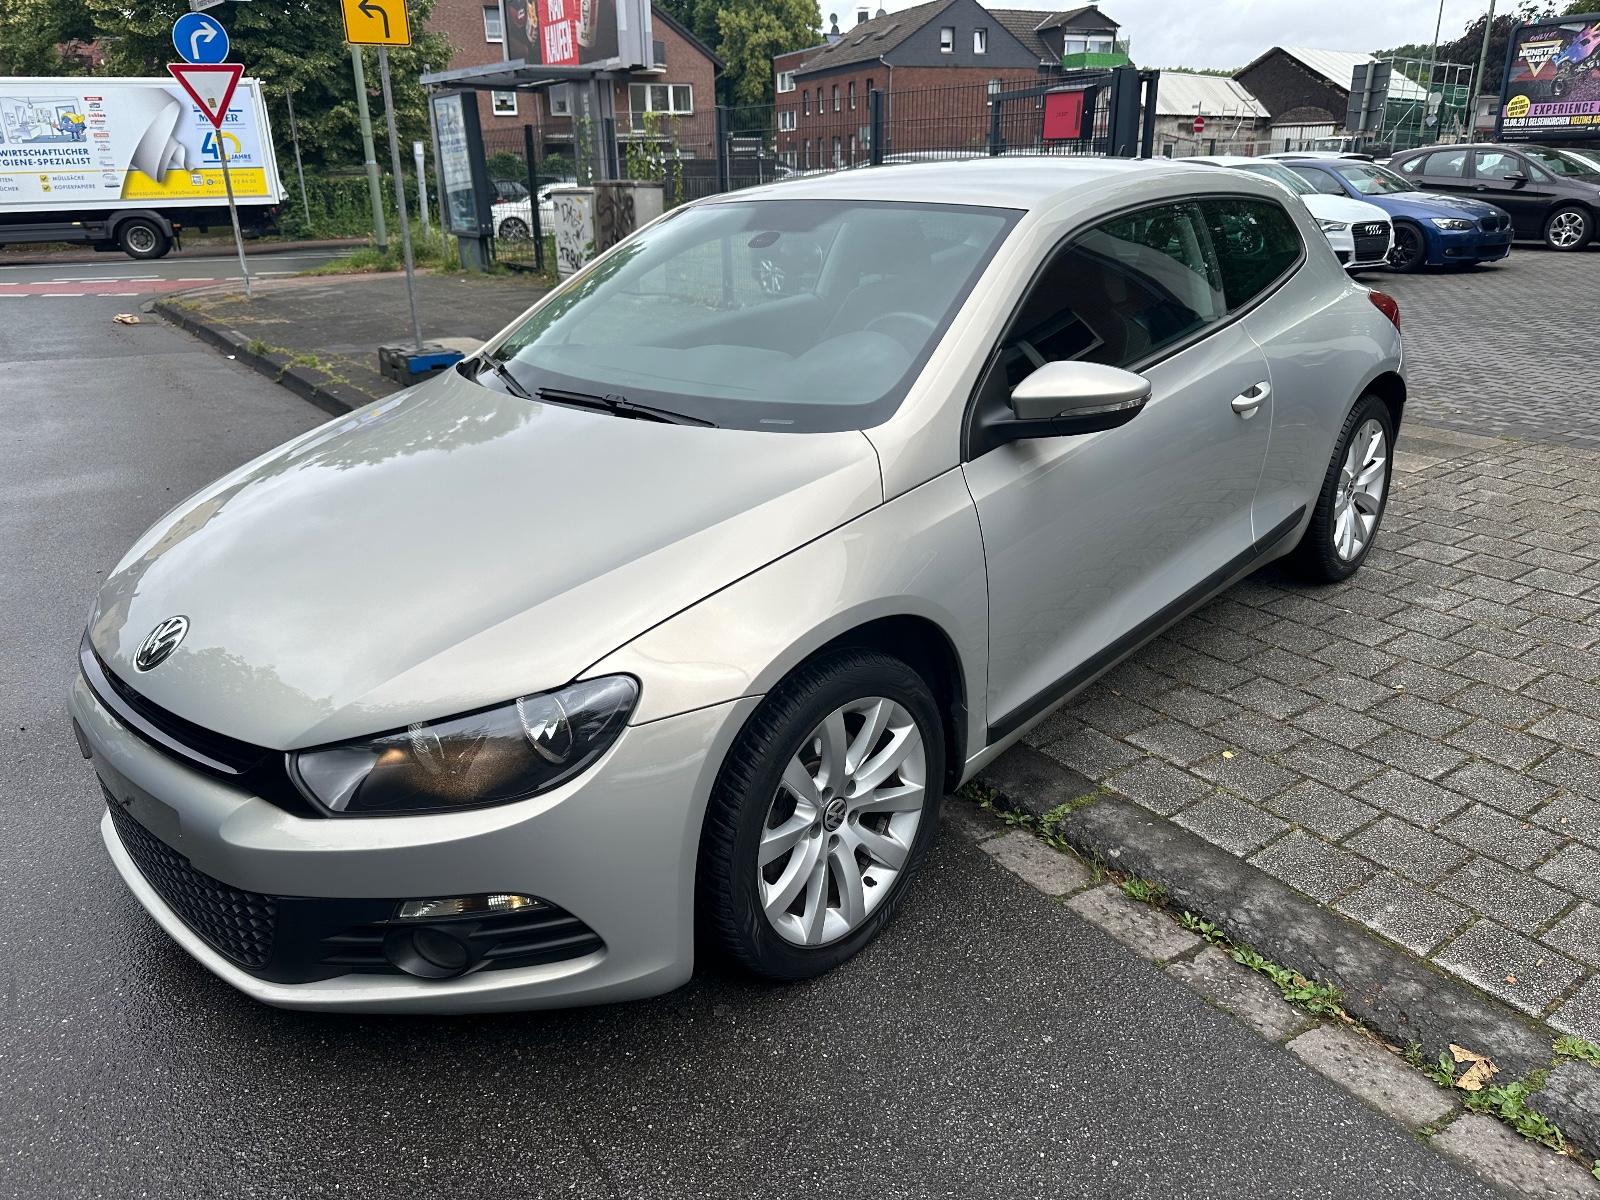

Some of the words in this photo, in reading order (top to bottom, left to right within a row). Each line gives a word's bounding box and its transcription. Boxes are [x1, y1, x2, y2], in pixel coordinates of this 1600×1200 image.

[544, 19, 573, 63] KAUFEN
[1519, 46, 1561, 57] MONSTER
[1528, 55, 1549, 63] JAM
[1533, 102, 1595, 115] EXPERIENCE
[1528, 116, 1570, 126] GELSENKIRCHEN
[1570, 115, 1592, 125] VELTINS
[0, 148, 89, 157] WIRTSCHAFTLICHER
[0, 157, 91, 166] GIENE-SPEZIALIST
